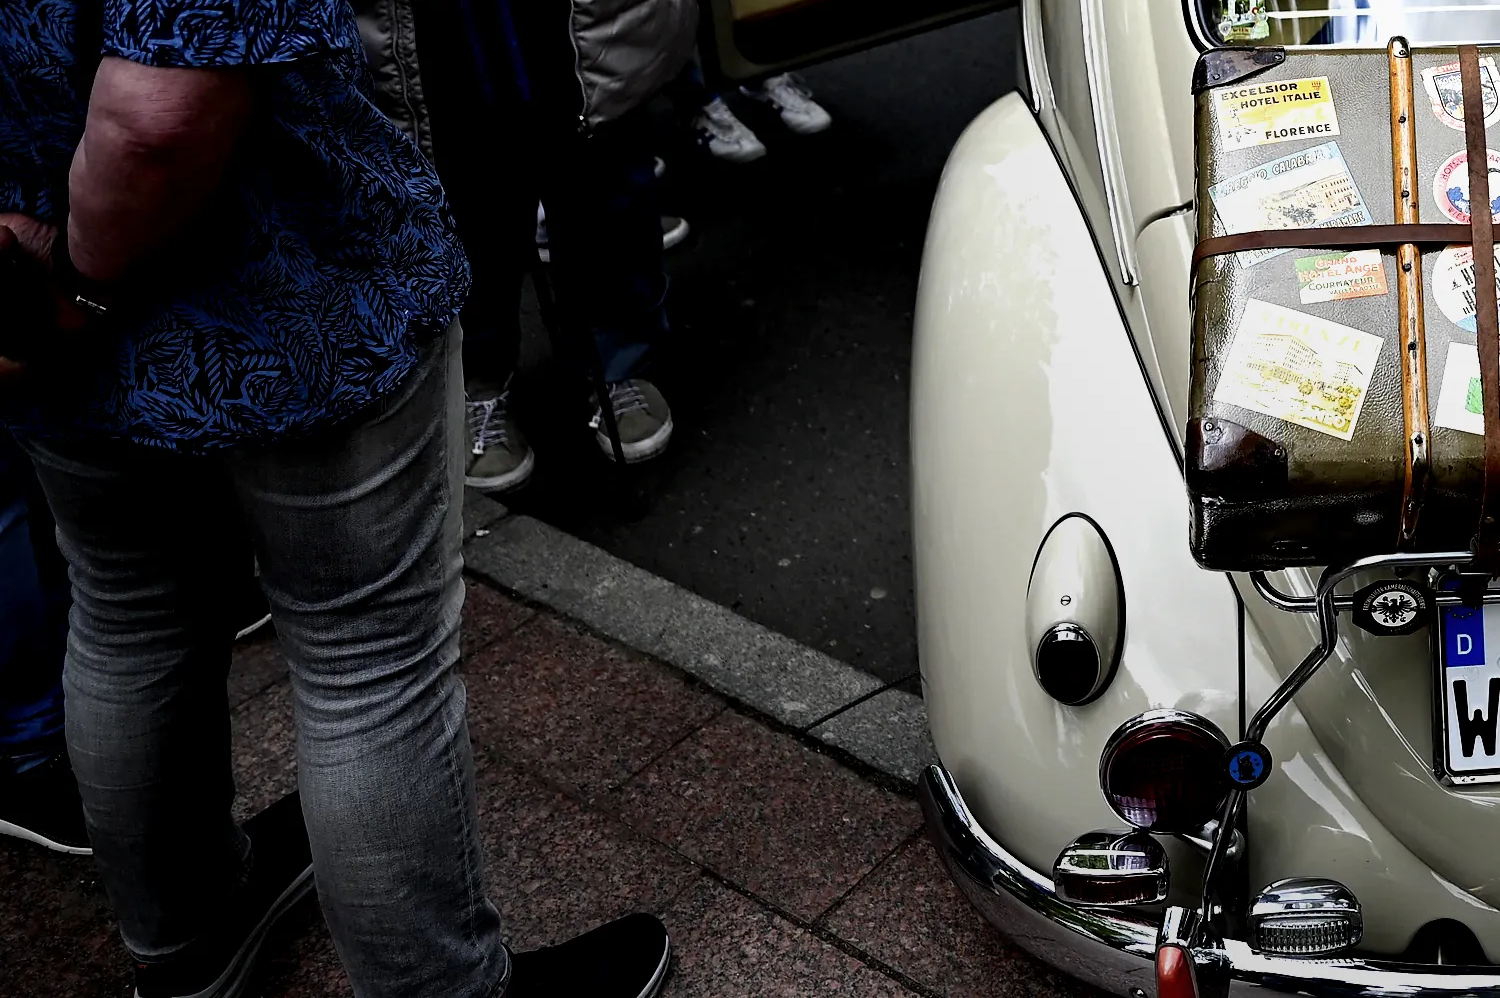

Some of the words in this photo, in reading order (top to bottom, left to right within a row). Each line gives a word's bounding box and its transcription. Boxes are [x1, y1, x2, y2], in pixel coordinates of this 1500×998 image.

[1221, 83, 1298, 101] EXCELSIOR
[1240, 97, 1280, 110] HOTEL
[1283, 91, 1321, 103] ITALIE
[1265, 123, 1332, 140] FLORENCE
[1457, 634, 1472, 655] D
